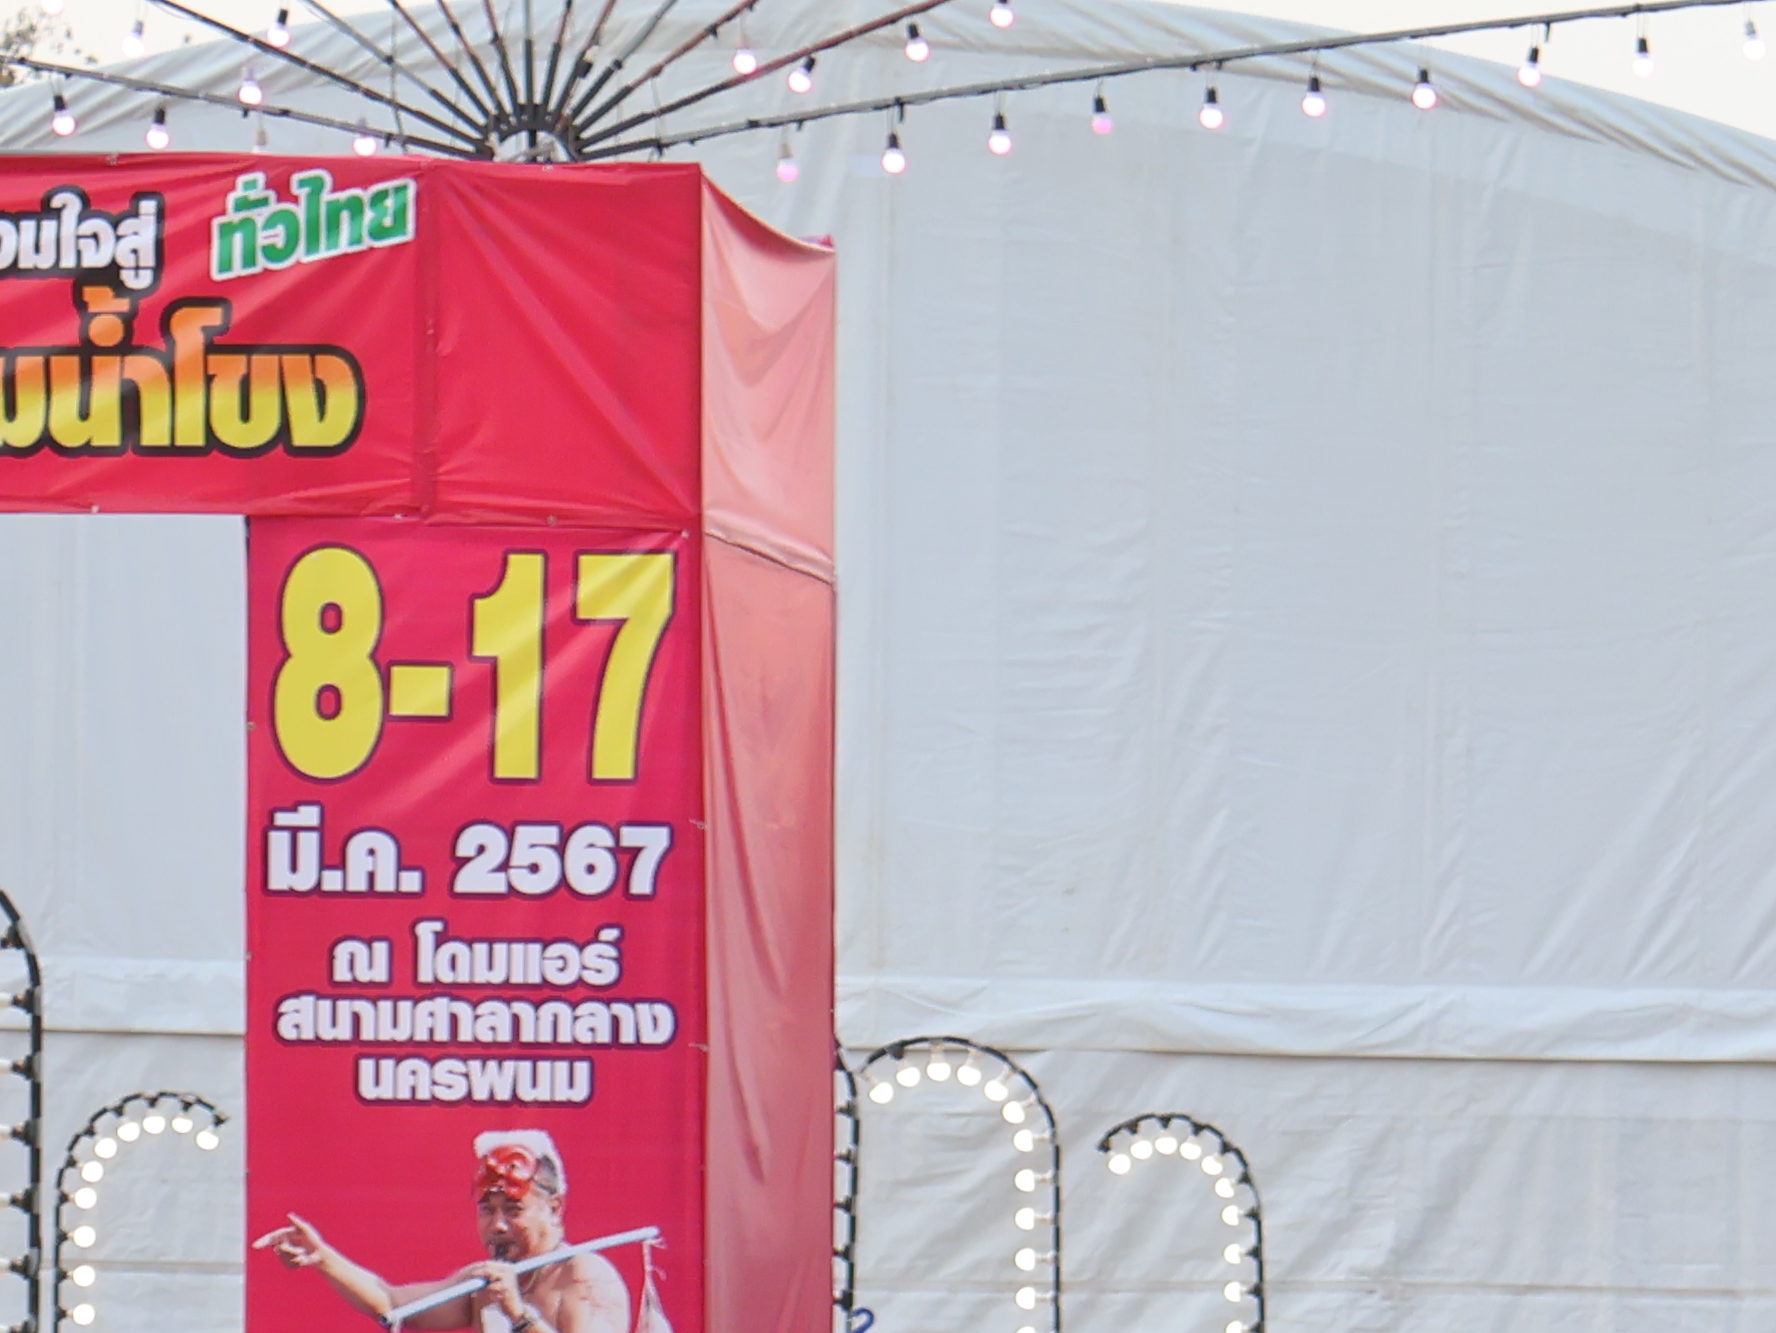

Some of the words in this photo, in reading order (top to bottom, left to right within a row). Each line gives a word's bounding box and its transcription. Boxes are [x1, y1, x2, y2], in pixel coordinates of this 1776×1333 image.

[214, 172, 414, 279] ทั่วไทย
[272, 545, 677, 783] 8-17
[266, 804, 423, 893] มี.ค.
[452, 823, 672, 894] 2567
[332, 939, 391, 984] ณ
[413, 921, 621, 985] โดมแอร์
[276, 995, 676, 1045] สนามศาลากลาง
[357, 1055, 594, 1103] นครพนม
